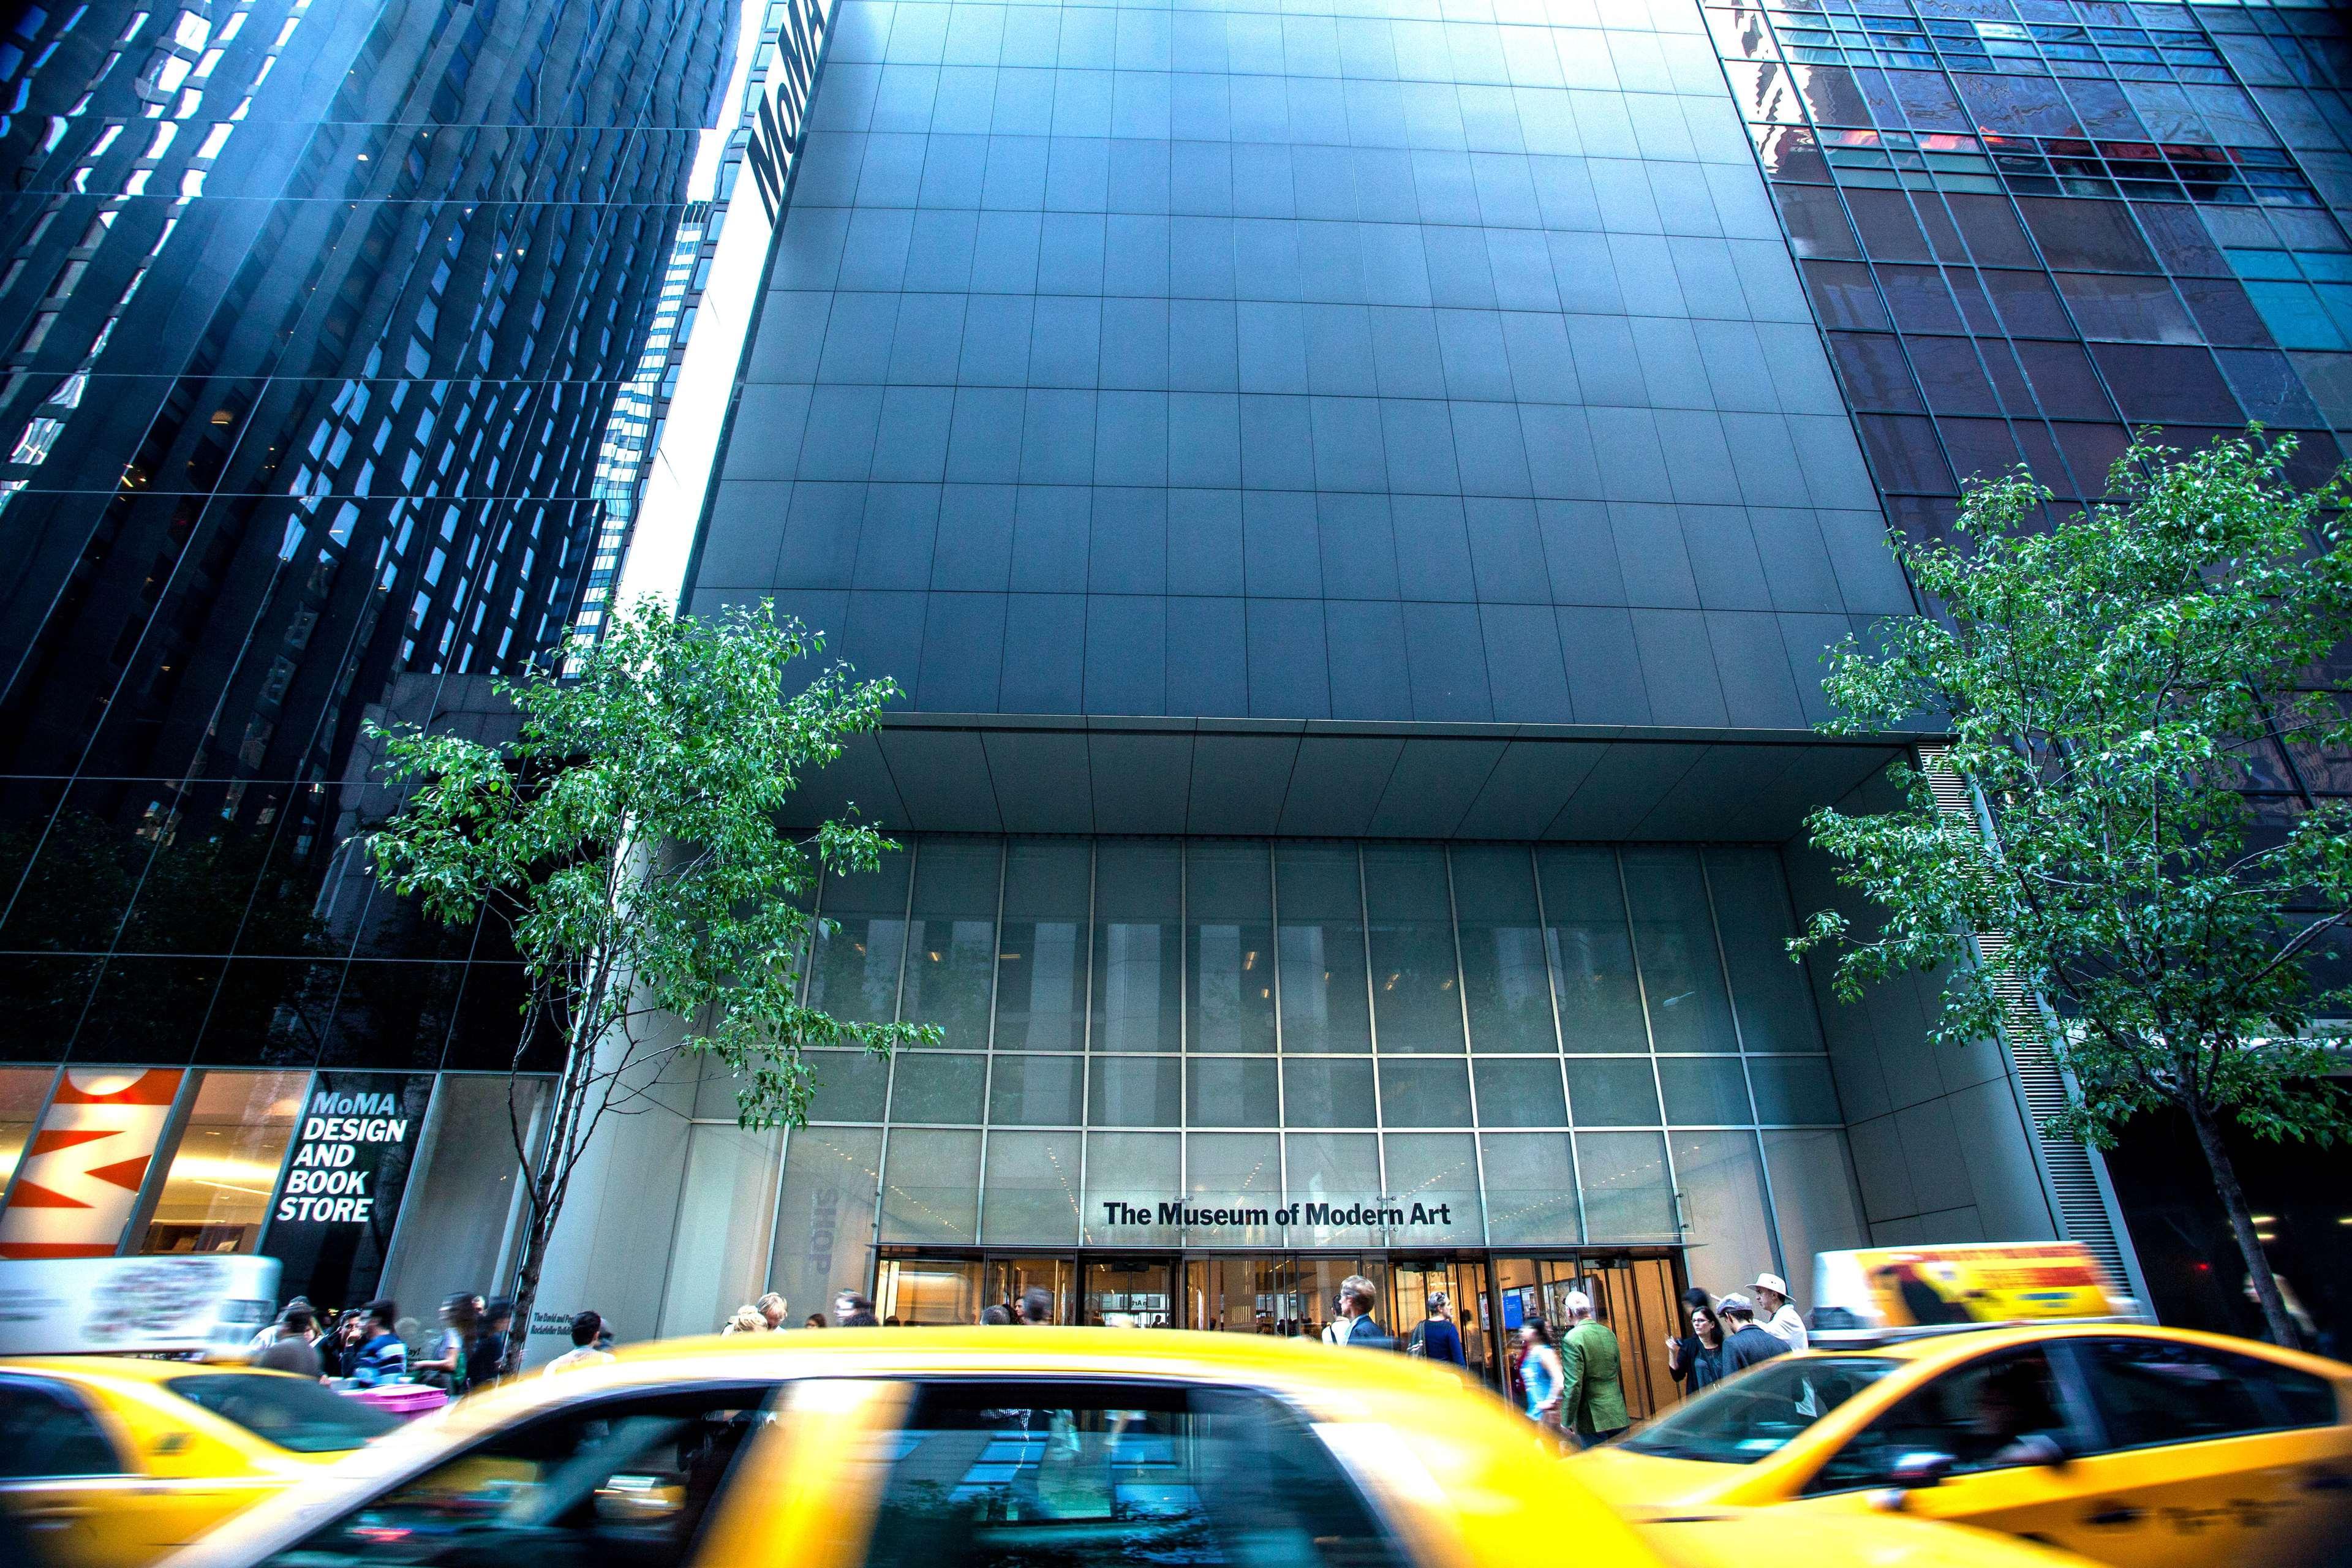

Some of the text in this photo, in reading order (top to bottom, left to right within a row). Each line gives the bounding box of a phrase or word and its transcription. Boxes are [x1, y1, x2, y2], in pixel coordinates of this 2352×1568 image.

[747, 0, 826, 229] MoMA
[311, 1091, 395, 1115] MoMA
[303, 1117, 408, 1142] DESIGN
[292, 1143, 356, 1167] AND
[285, 1170, 369, 1194] BOOK
[277, 1196, 374, 1222] STORE
[1103, 1202, 1451, 1226] The Museum of Modern Art
